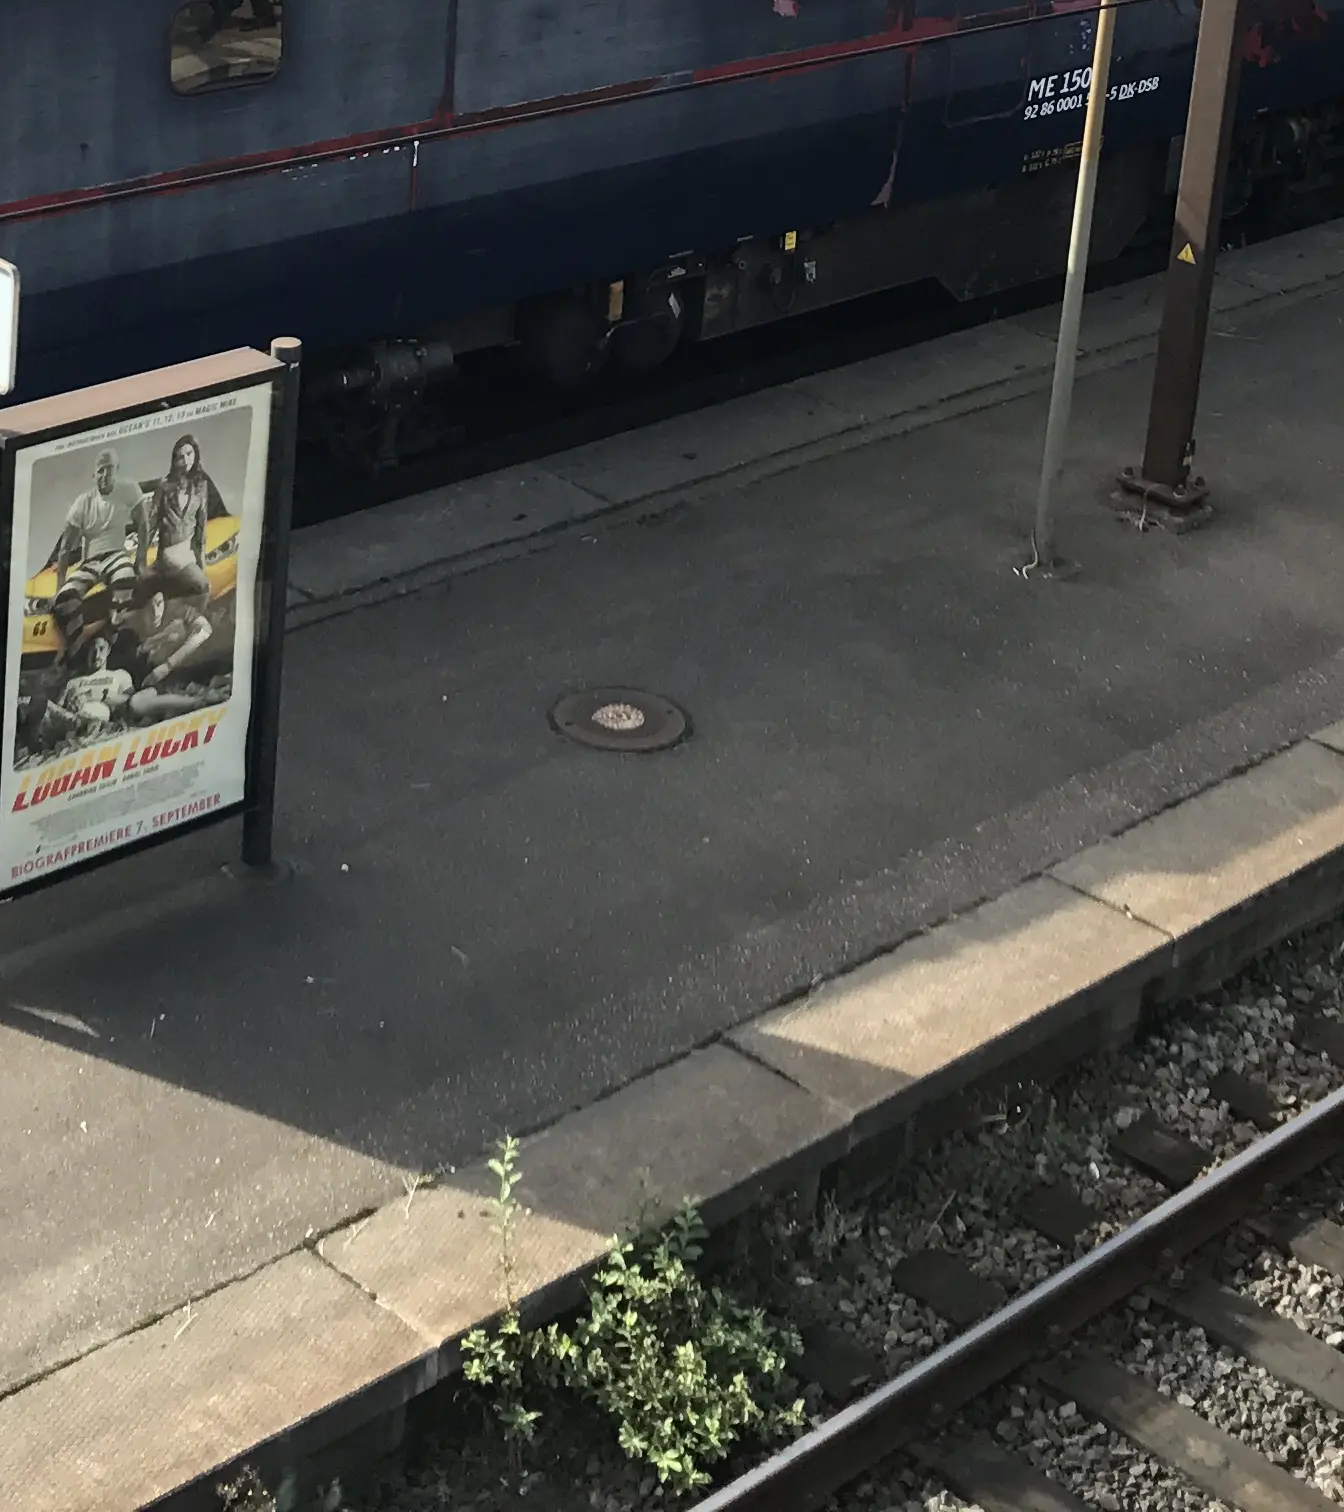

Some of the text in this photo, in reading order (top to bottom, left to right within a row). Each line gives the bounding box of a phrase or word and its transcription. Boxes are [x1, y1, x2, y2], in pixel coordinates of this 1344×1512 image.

[1024, 103, 1038, 120] 92
[1040, 100, 1055, 116] 86
[1057, 94, 1082, 112] 0001
[1118, 77, 1159, 100] DK-DSB
[1027, 67, 1092, 101] ME 150
[12, 741, 122, 813] LOGAN
[122, 706, 228, 773] LUCKY
[11, 823, 132, 879] BIOGRAFPREMIERE
[152, 792, 221, 829] SEPTEMBER
